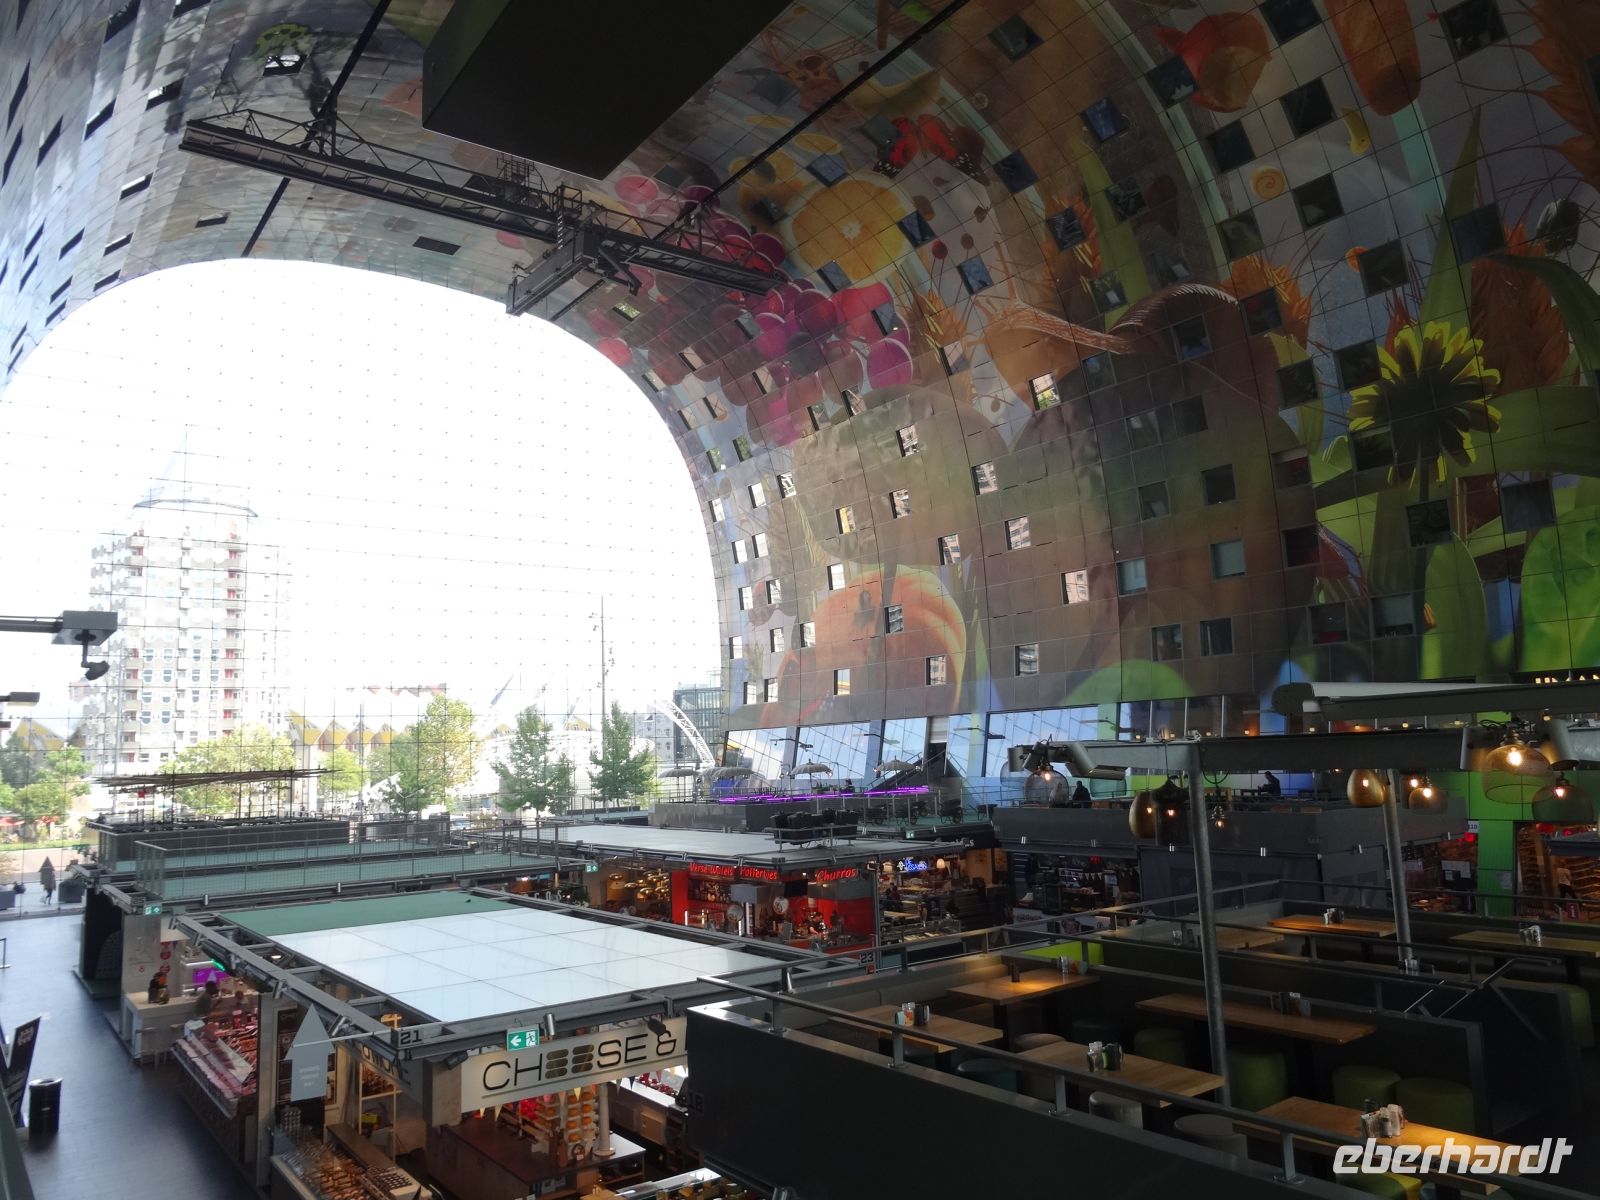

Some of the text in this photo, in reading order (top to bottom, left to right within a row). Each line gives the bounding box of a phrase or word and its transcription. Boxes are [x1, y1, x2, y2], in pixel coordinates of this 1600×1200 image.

[816, 867, 857, 882] Churros
[860, 952, 874, 964] 23
[400, 1030, 422, 1044] 21
